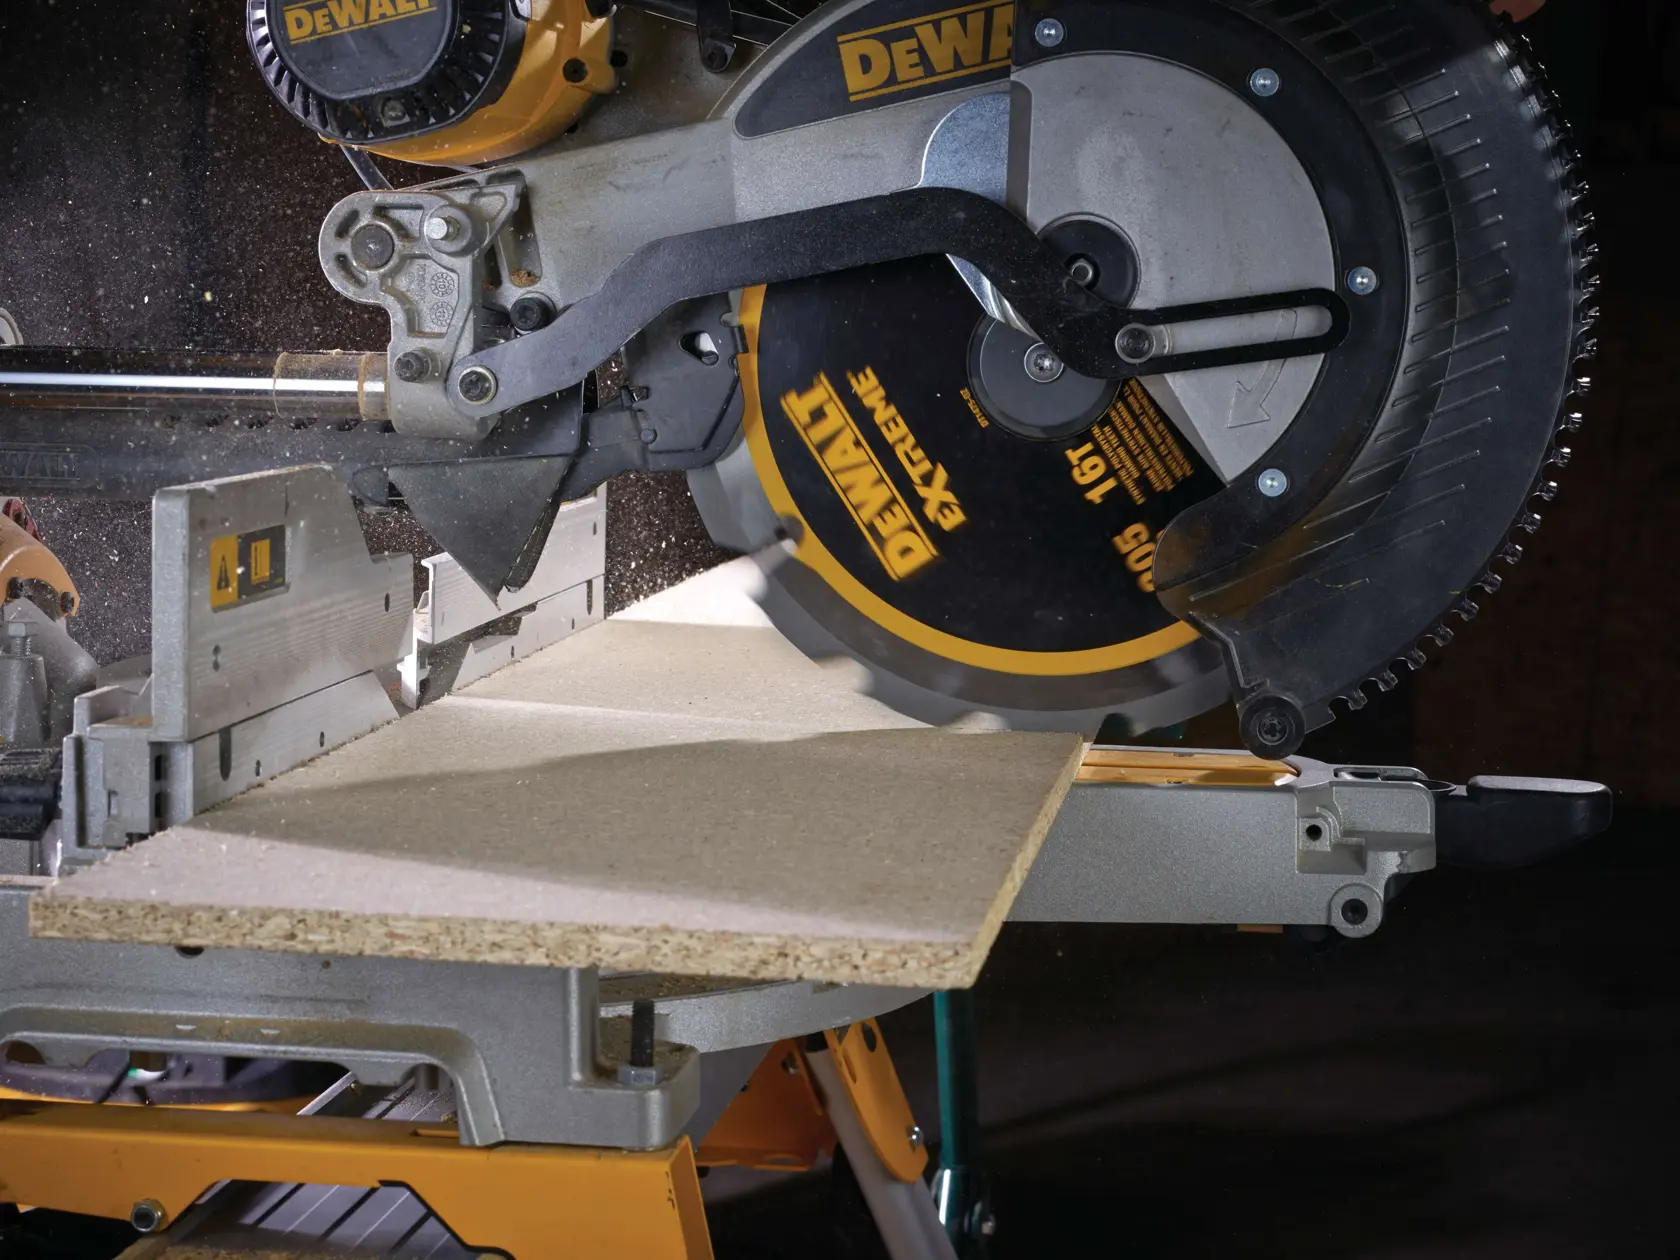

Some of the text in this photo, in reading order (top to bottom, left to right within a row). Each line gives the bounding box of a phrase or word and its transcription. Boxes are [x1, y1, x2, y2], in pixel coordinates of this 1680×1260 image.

[782, 375, 936, 580] DEWALT
[847, 365, 967, 532] EXTREME
[1064, 442, 1119, 504] 16T
